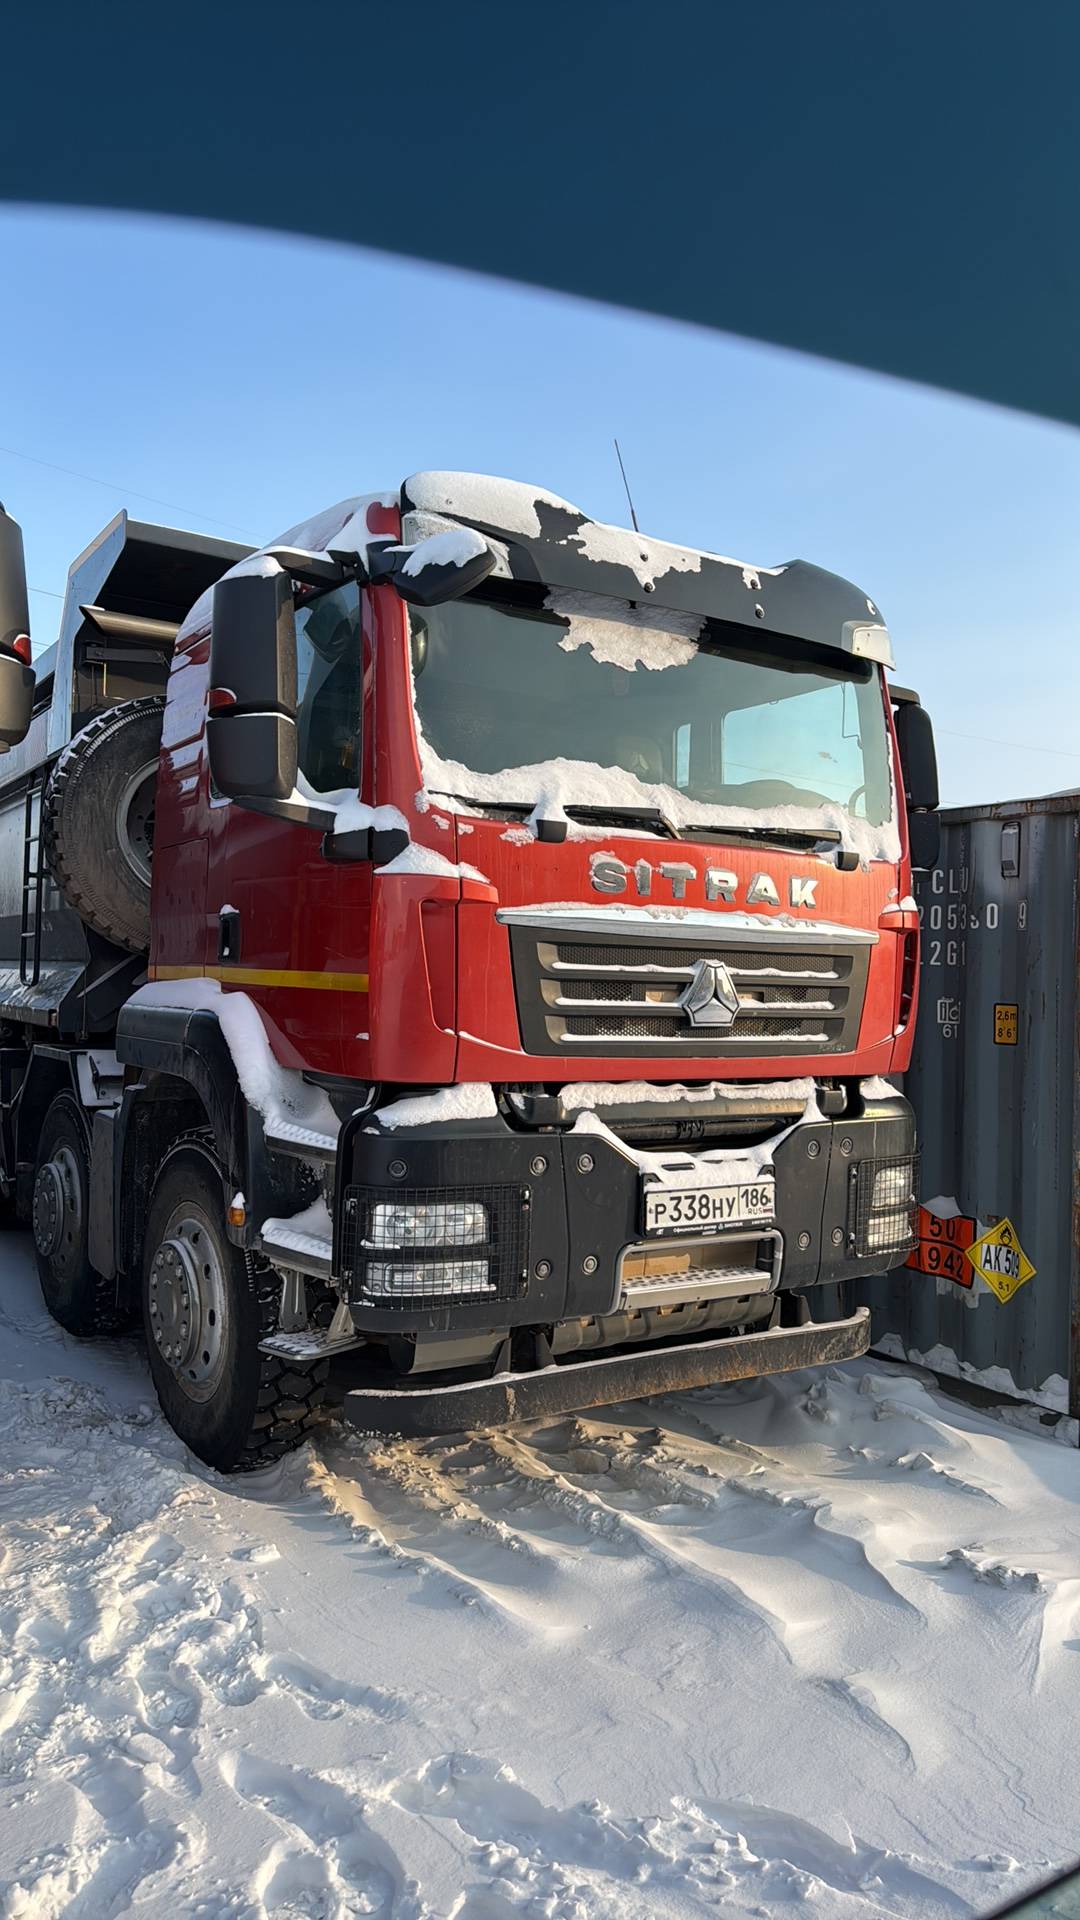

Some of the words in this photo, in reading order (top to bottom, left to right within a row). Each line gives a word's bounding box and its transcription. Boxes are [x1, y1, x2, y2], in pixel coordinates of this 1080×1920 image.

[591, 857, 819, 909] SITRAK
[943, 1024, 958, 1039] 61
[741, 1187, 769, 1208] 186
[998, 1281, 1010, 1292] 5.1
